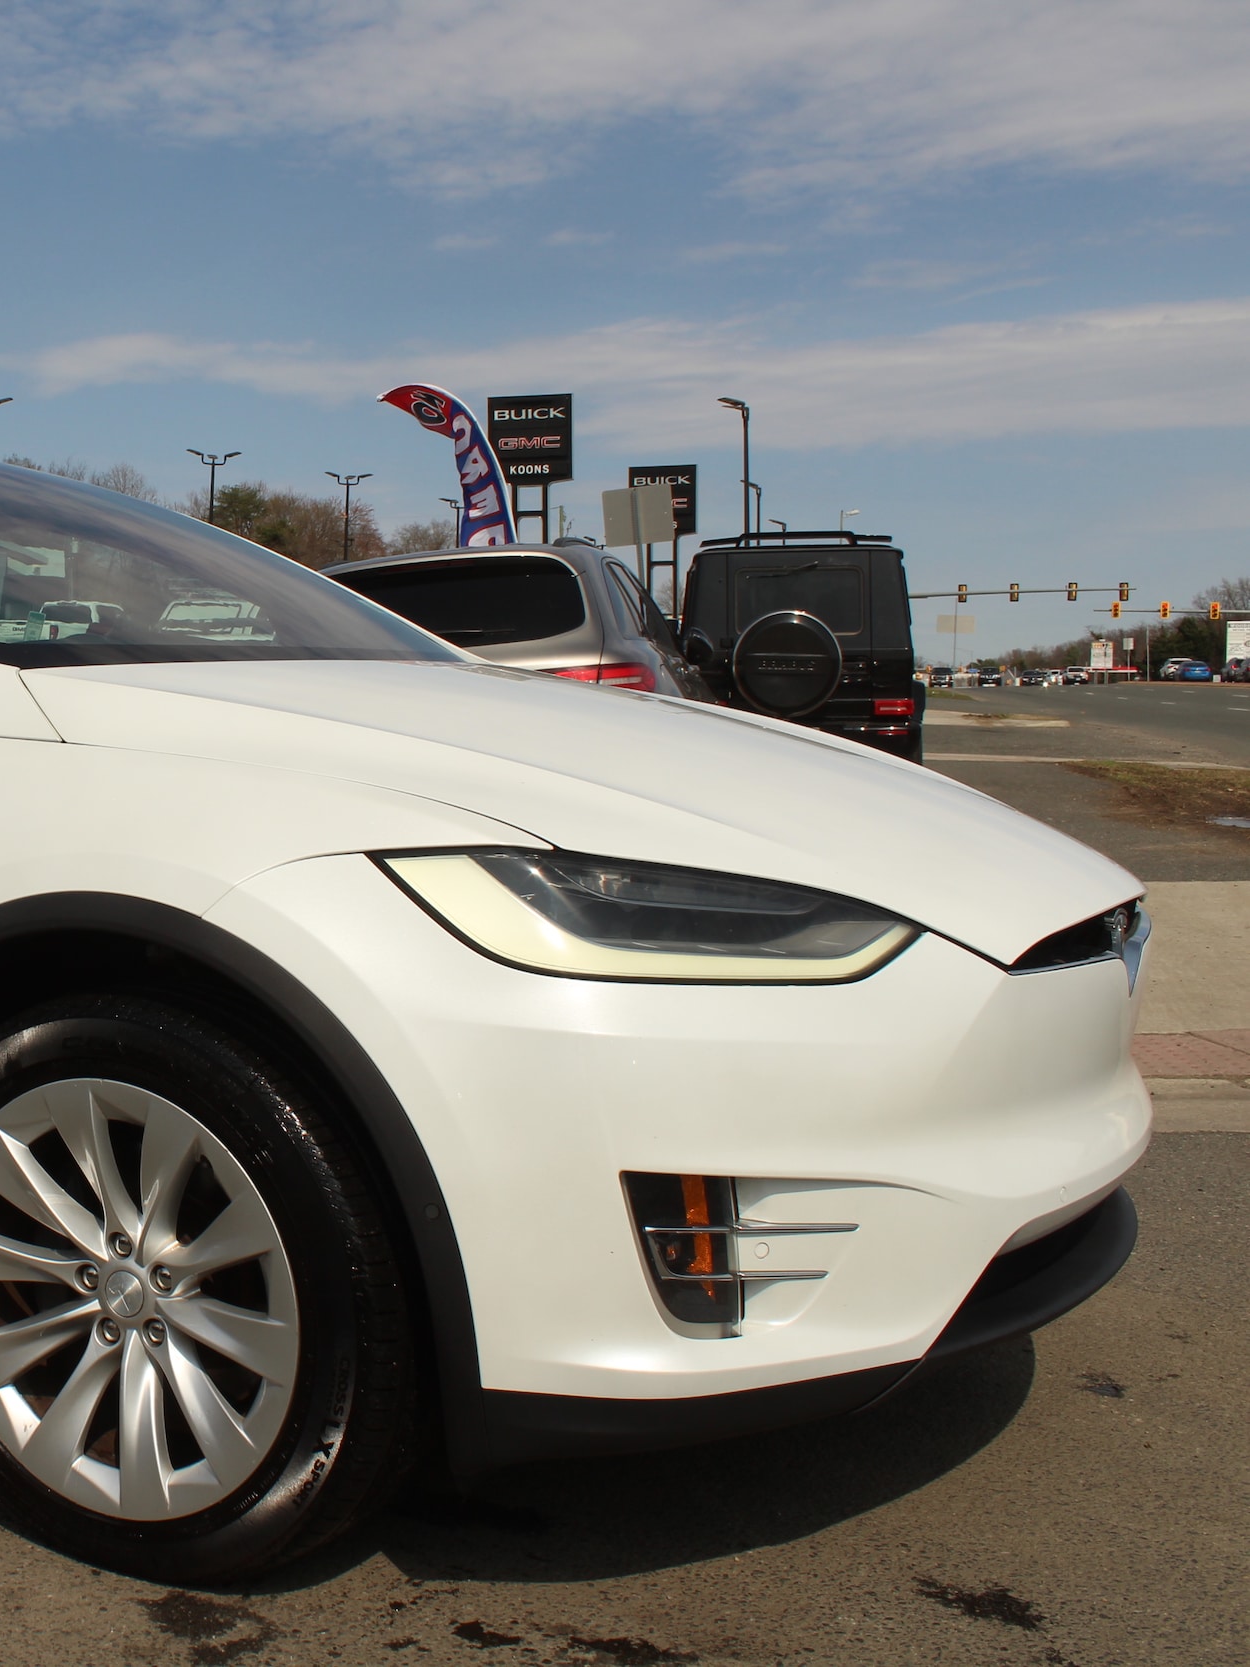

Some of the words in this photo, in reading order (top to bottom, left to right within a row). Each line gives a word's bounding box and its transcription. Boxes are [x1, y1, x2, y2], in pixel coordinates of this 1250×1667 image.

[493, 407, 566, 421] BUICK
[498, 436, 561, 450] GMC
[510, 464, 550, 475] KOONS
[633, 475, 691, 486] BUICK
